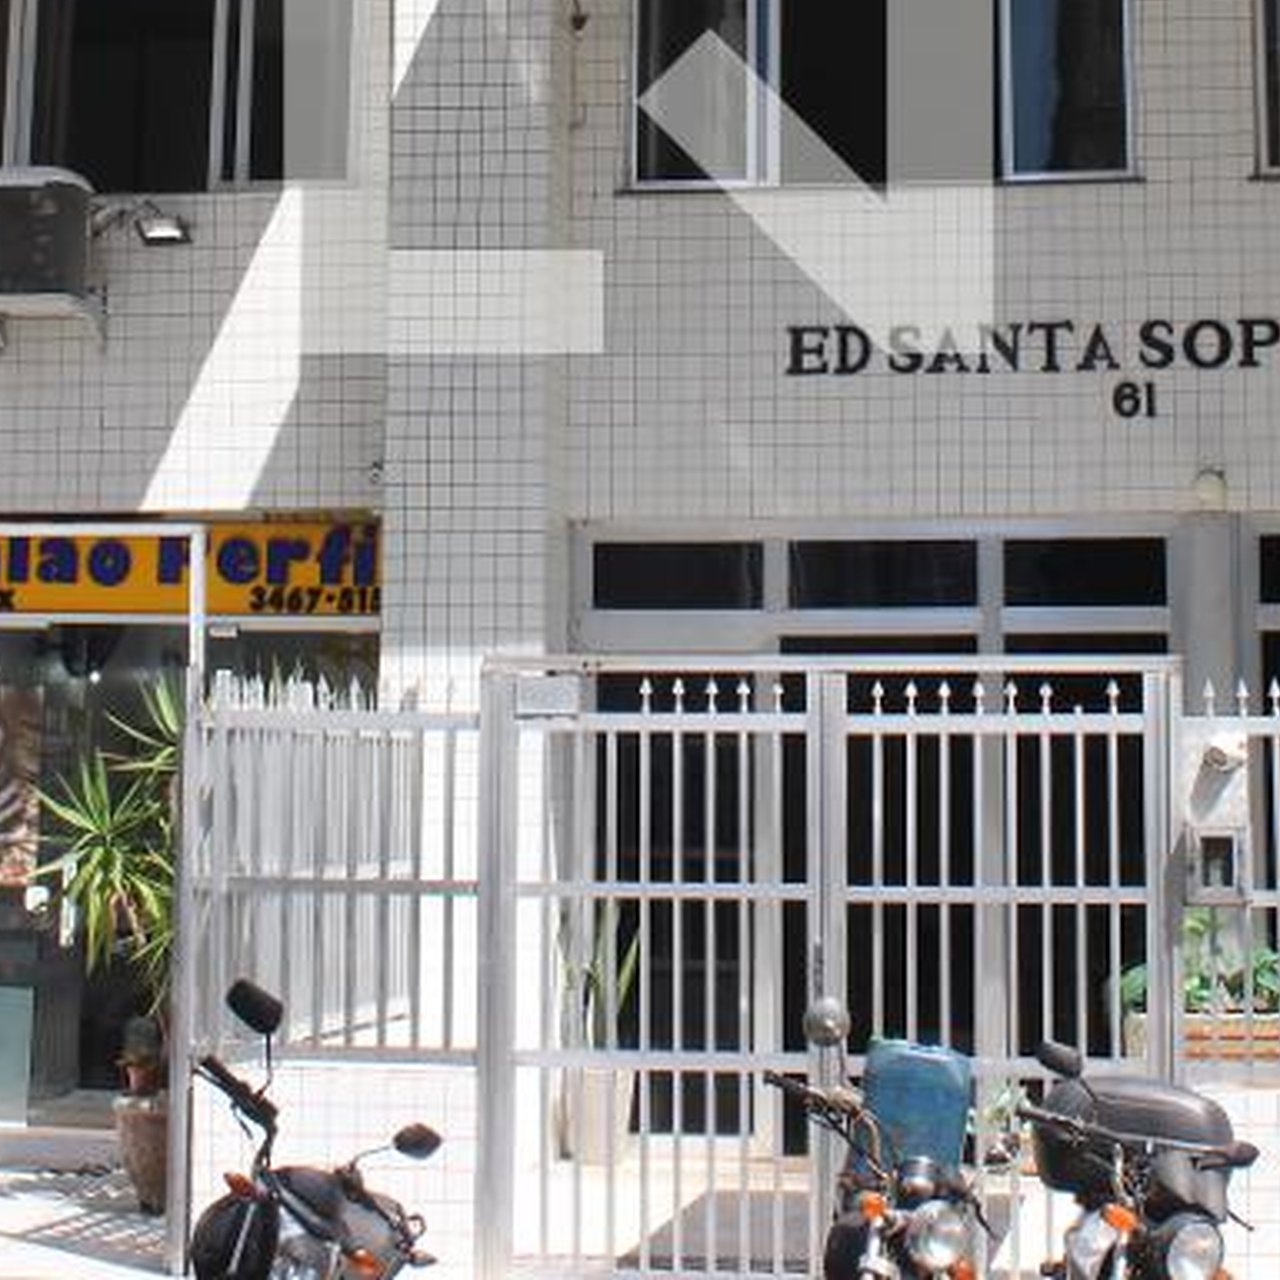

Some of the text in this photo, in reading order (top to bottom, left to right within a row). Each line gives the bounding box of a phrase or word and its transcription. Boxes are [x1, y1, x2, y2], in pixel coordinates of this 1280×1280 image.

[785, 325, 873, 376] ED
[887, 321, 1120, 374] SANTA
[1112, 382, 1157, 418] 61
